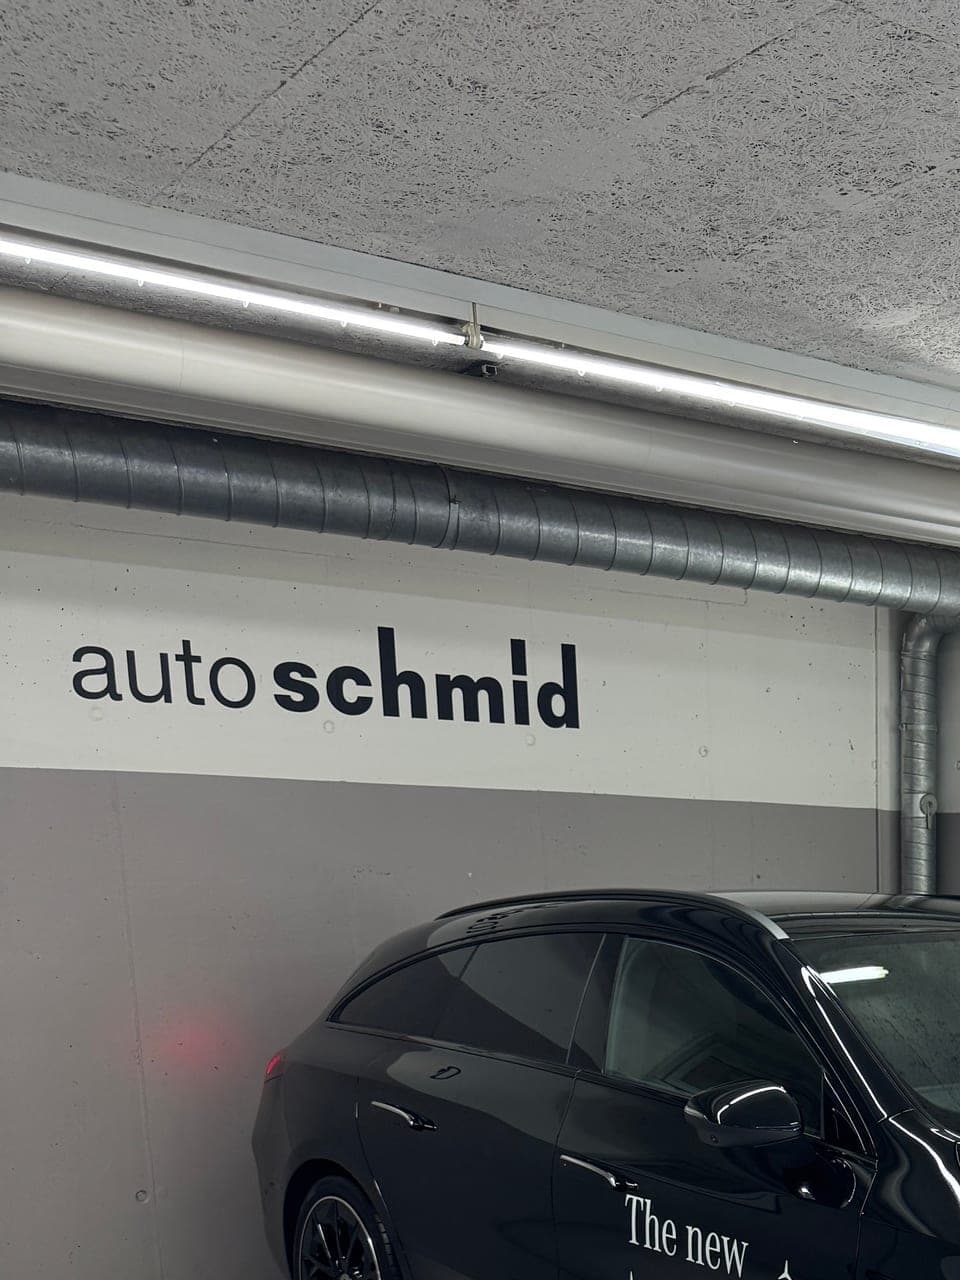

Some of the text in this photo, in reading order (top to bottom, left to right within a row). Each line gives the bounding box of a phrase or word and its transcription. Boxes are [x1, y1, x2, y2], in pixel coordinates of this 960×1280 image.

[72, 626, 581, 730] auto schmid
[624, 1193, 749, 1278] The new
